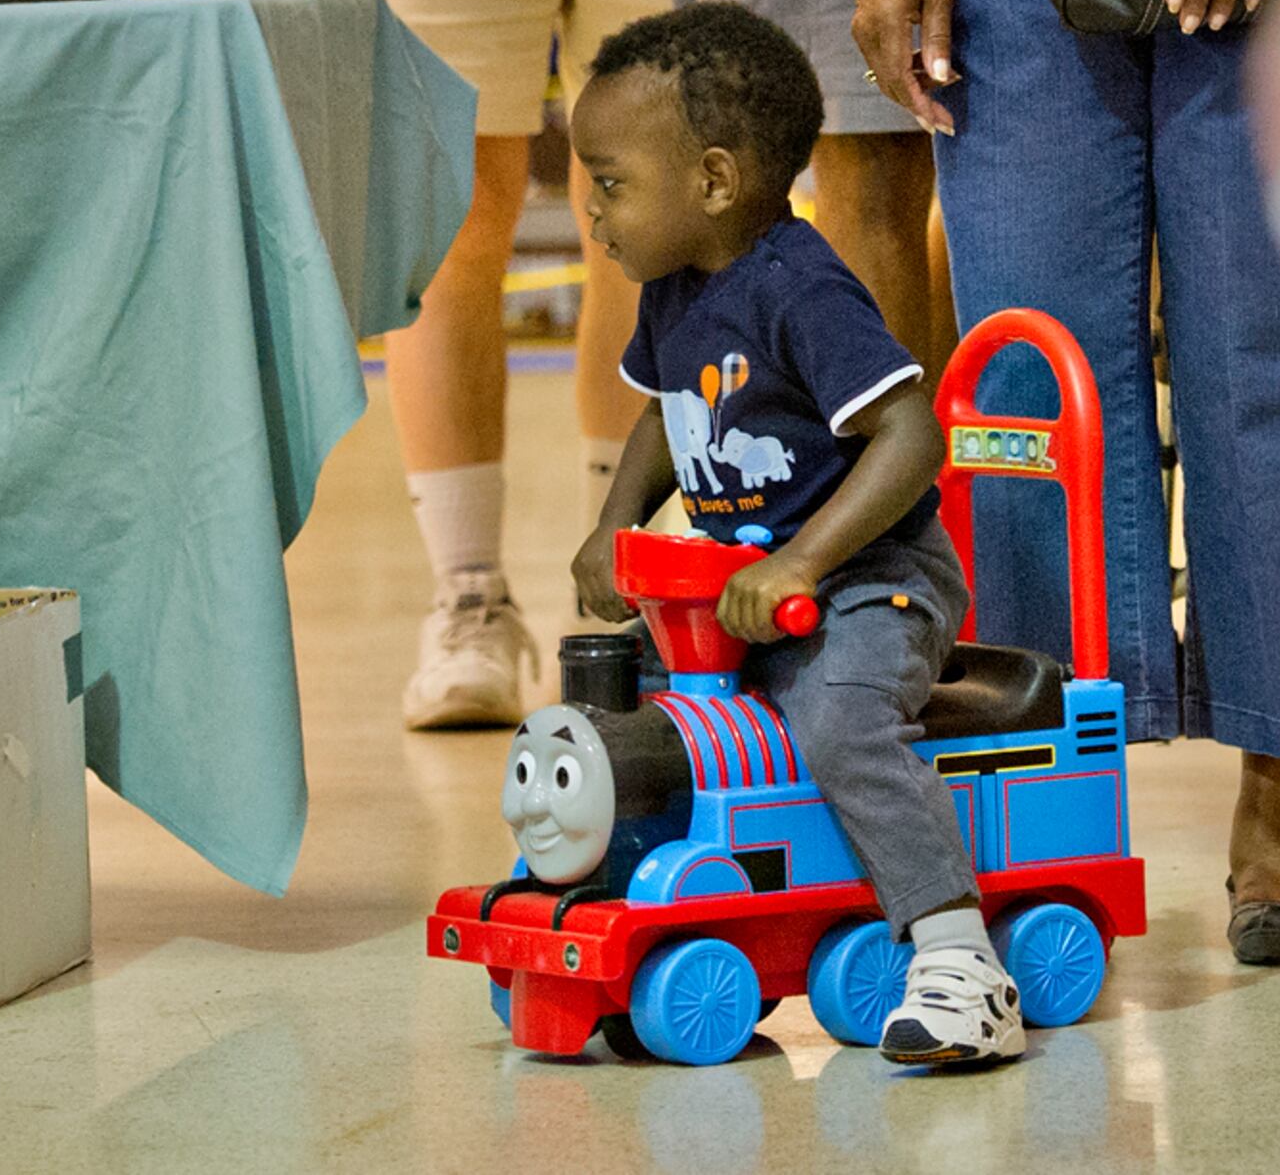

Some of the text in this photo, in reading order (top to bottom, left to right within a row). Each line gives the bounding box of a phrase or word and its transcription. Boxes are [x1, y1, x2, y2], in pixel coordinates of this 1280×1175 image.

[696, 496, 734, 513] loves
[737, 494, 764, 511] me
[9, 596, 25, 607] for
